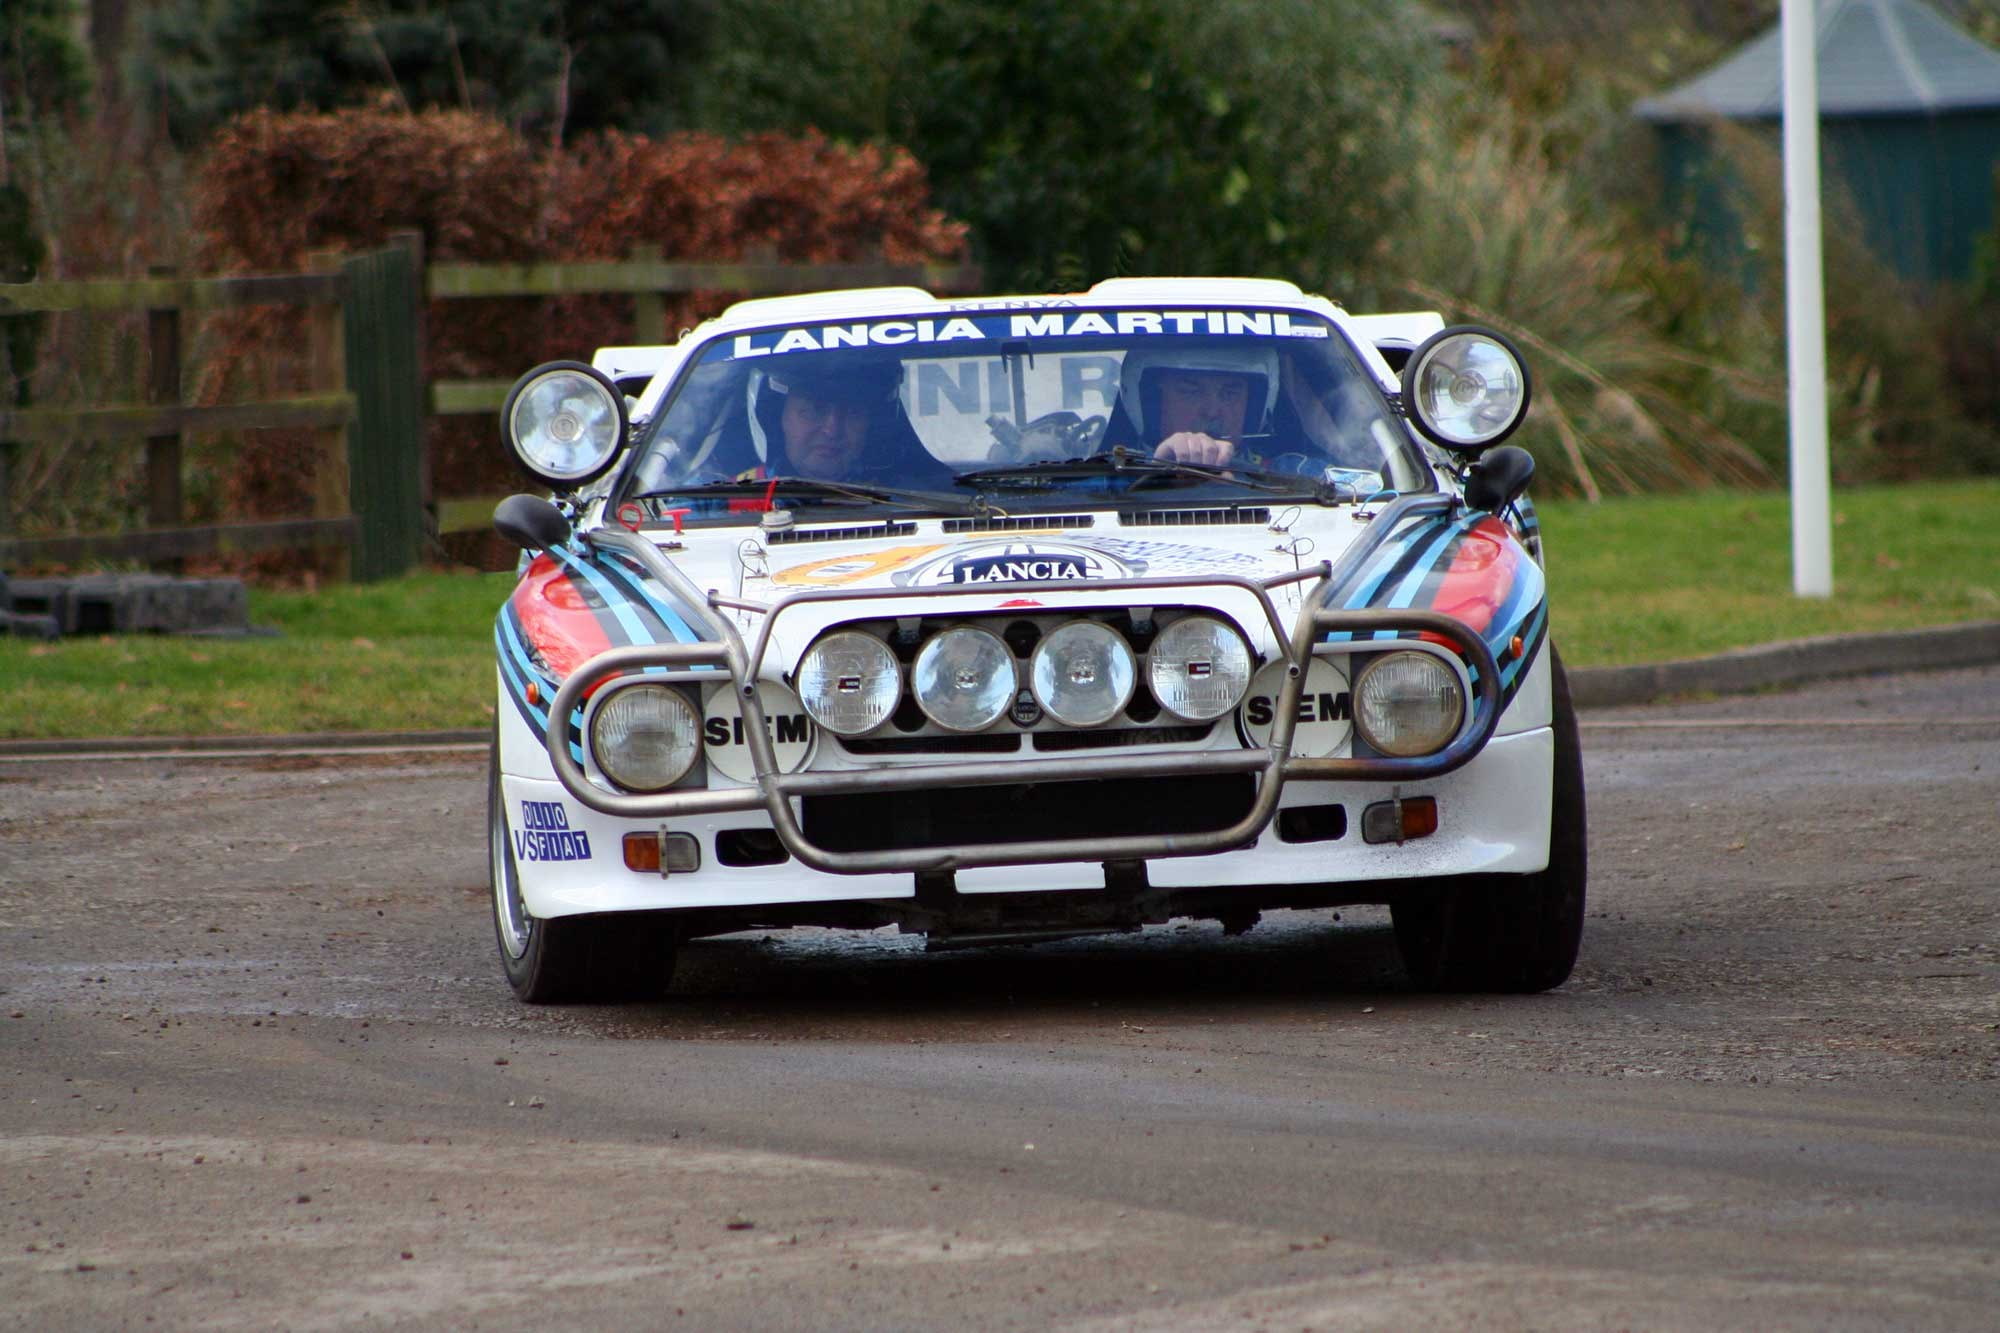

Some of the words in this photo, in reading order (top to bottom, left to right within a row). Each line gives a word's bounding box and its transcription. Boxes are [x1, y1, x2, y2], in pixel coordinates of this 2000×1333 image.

[734, 318, 985, 359] LANCIA
[1010, 311, 1292, 337] MARTINI
[962, 561, 1084, 584] LANCIA
[1247, 692, 1351, 726] SEM
[522, 802, 567, 828] OLIO
